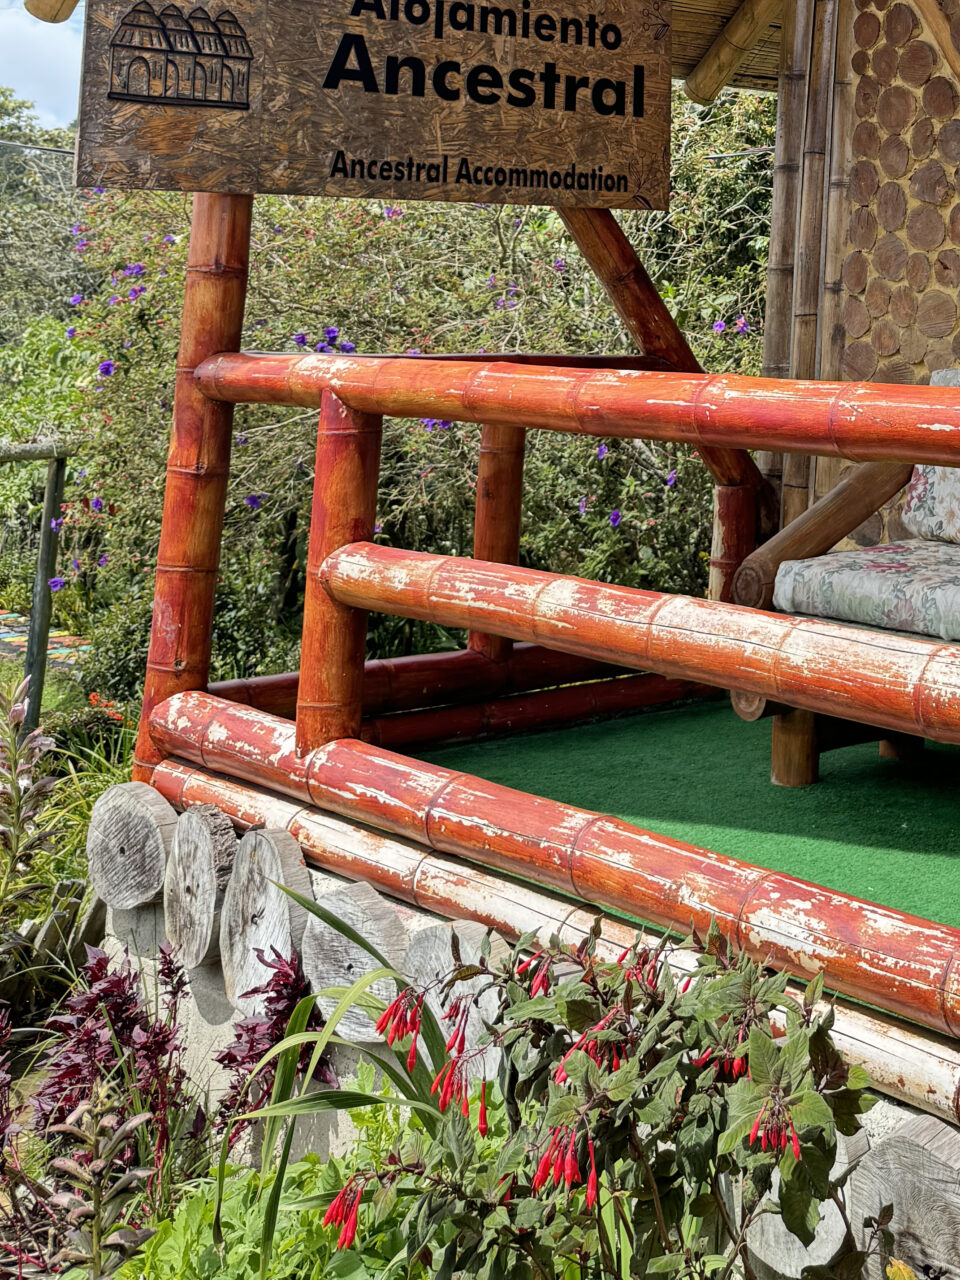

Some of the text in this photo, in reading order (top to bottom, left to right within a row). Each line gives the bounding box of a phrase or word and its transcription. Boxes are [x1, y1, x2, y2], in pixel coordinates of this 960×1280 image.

[322, 32, 646, 118] Ancestral
[329, 150, 629, 193] Ancestral Accommodation
